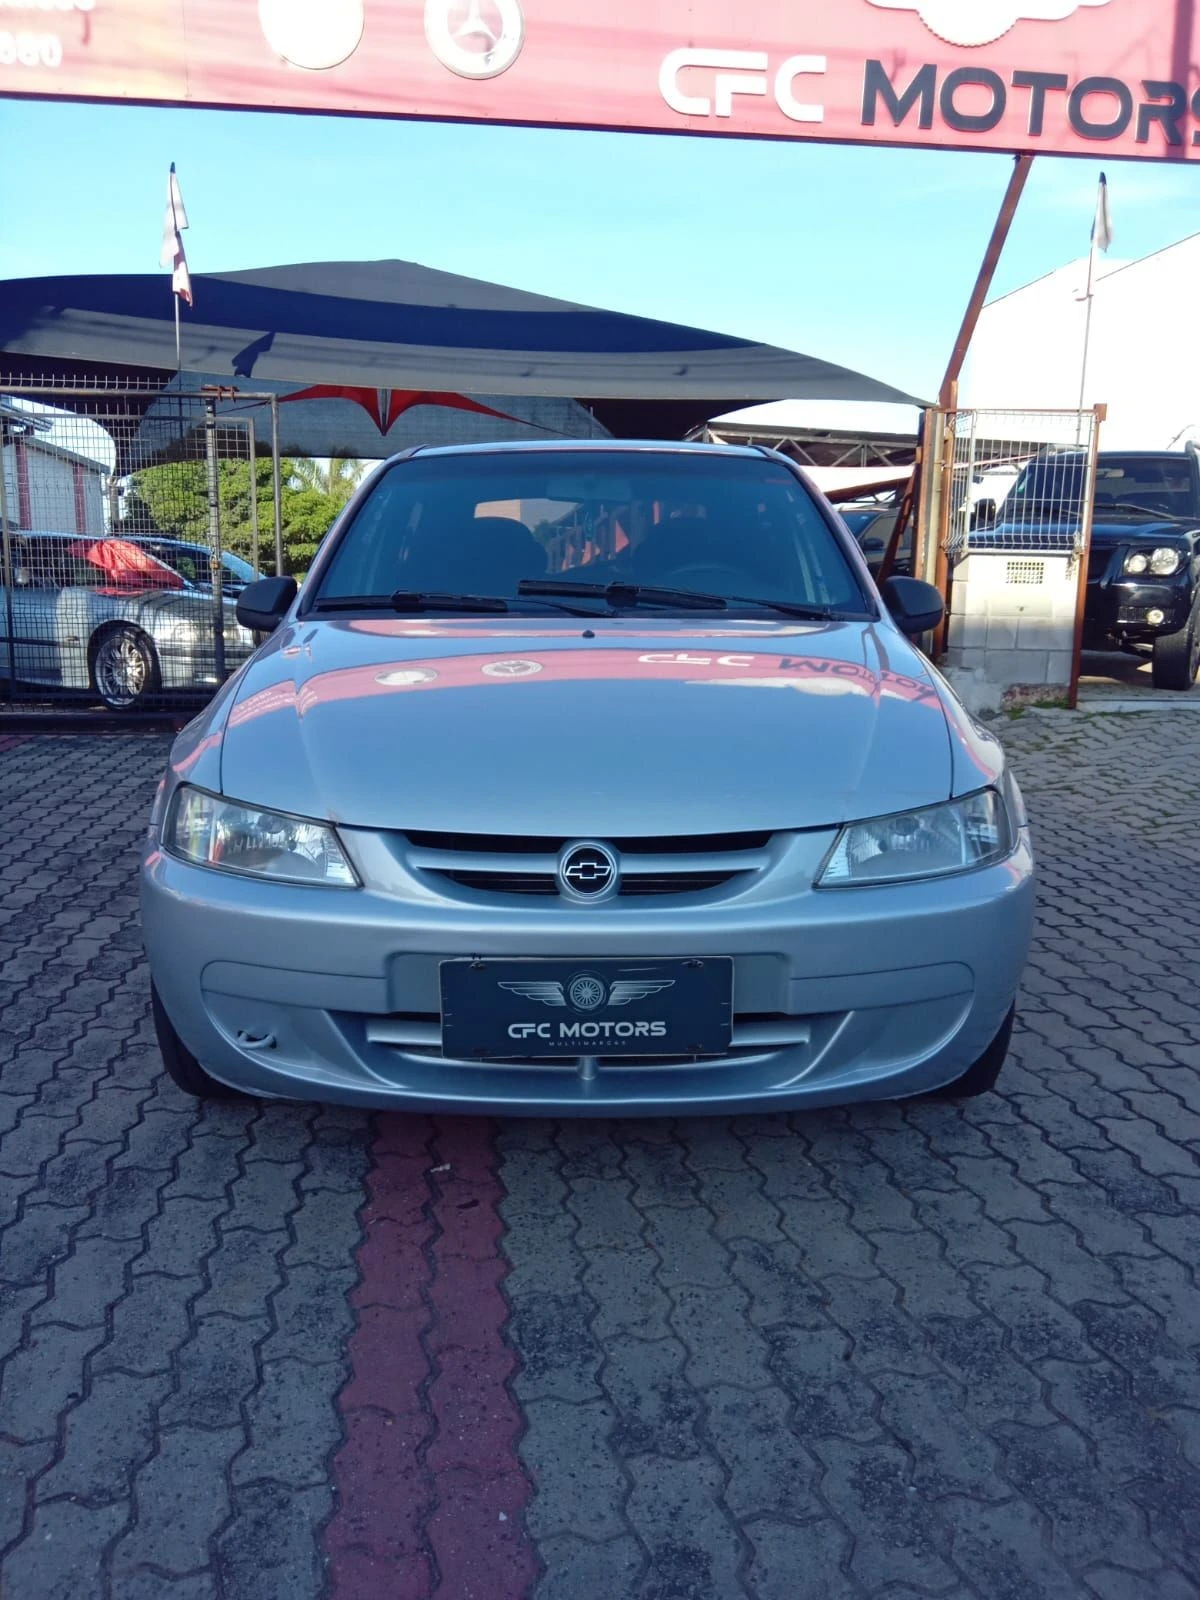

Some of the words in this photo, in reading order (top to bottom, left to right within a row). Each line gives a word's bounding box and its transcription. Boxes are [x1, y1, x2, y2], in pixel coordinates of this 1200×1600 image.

[659, 47, 827, 122] CFC
[861, 59, 1200, 147] MOTOR
[508, 1023, 550, 1038] CFC
[559, 1021, 667, 1038] MOTORS
